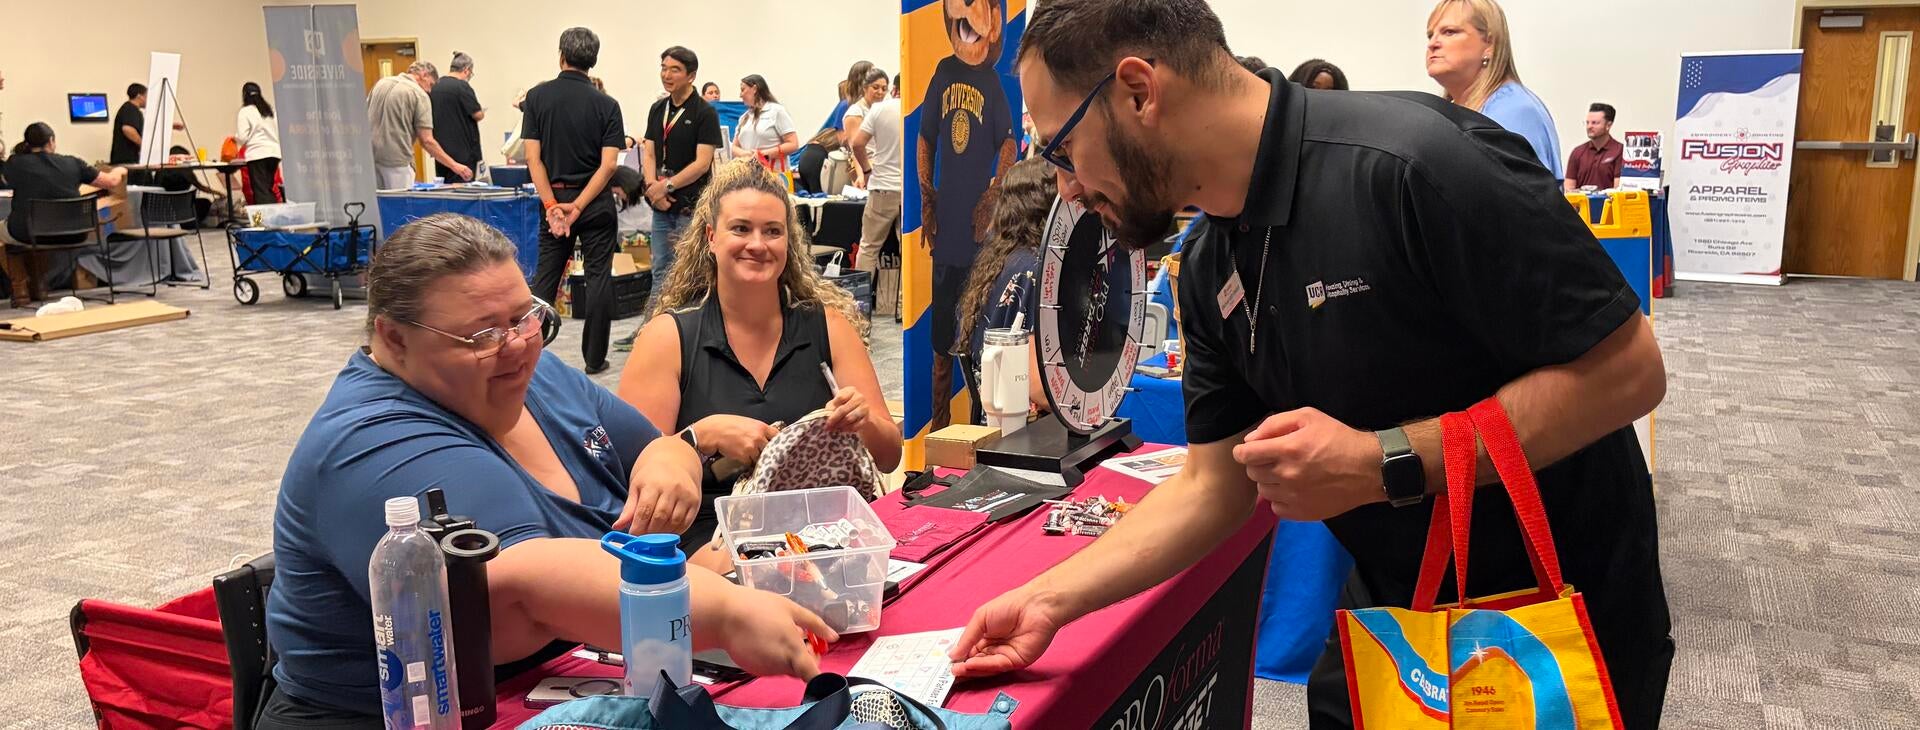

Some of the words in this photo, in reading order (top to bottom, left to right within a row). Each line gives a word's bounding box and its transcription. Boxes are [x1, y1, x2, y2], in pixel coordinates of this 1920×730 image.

[949, 83, 985, 125] RIVERSIDE
[1689, 185, 1768, 196] APPAREL
[375, 614, 390, 682] smart
[384, 615, 394, 647] water
[428, 608, 449, 716] smartwater
[1471, 685, 1496, 696] 1946
